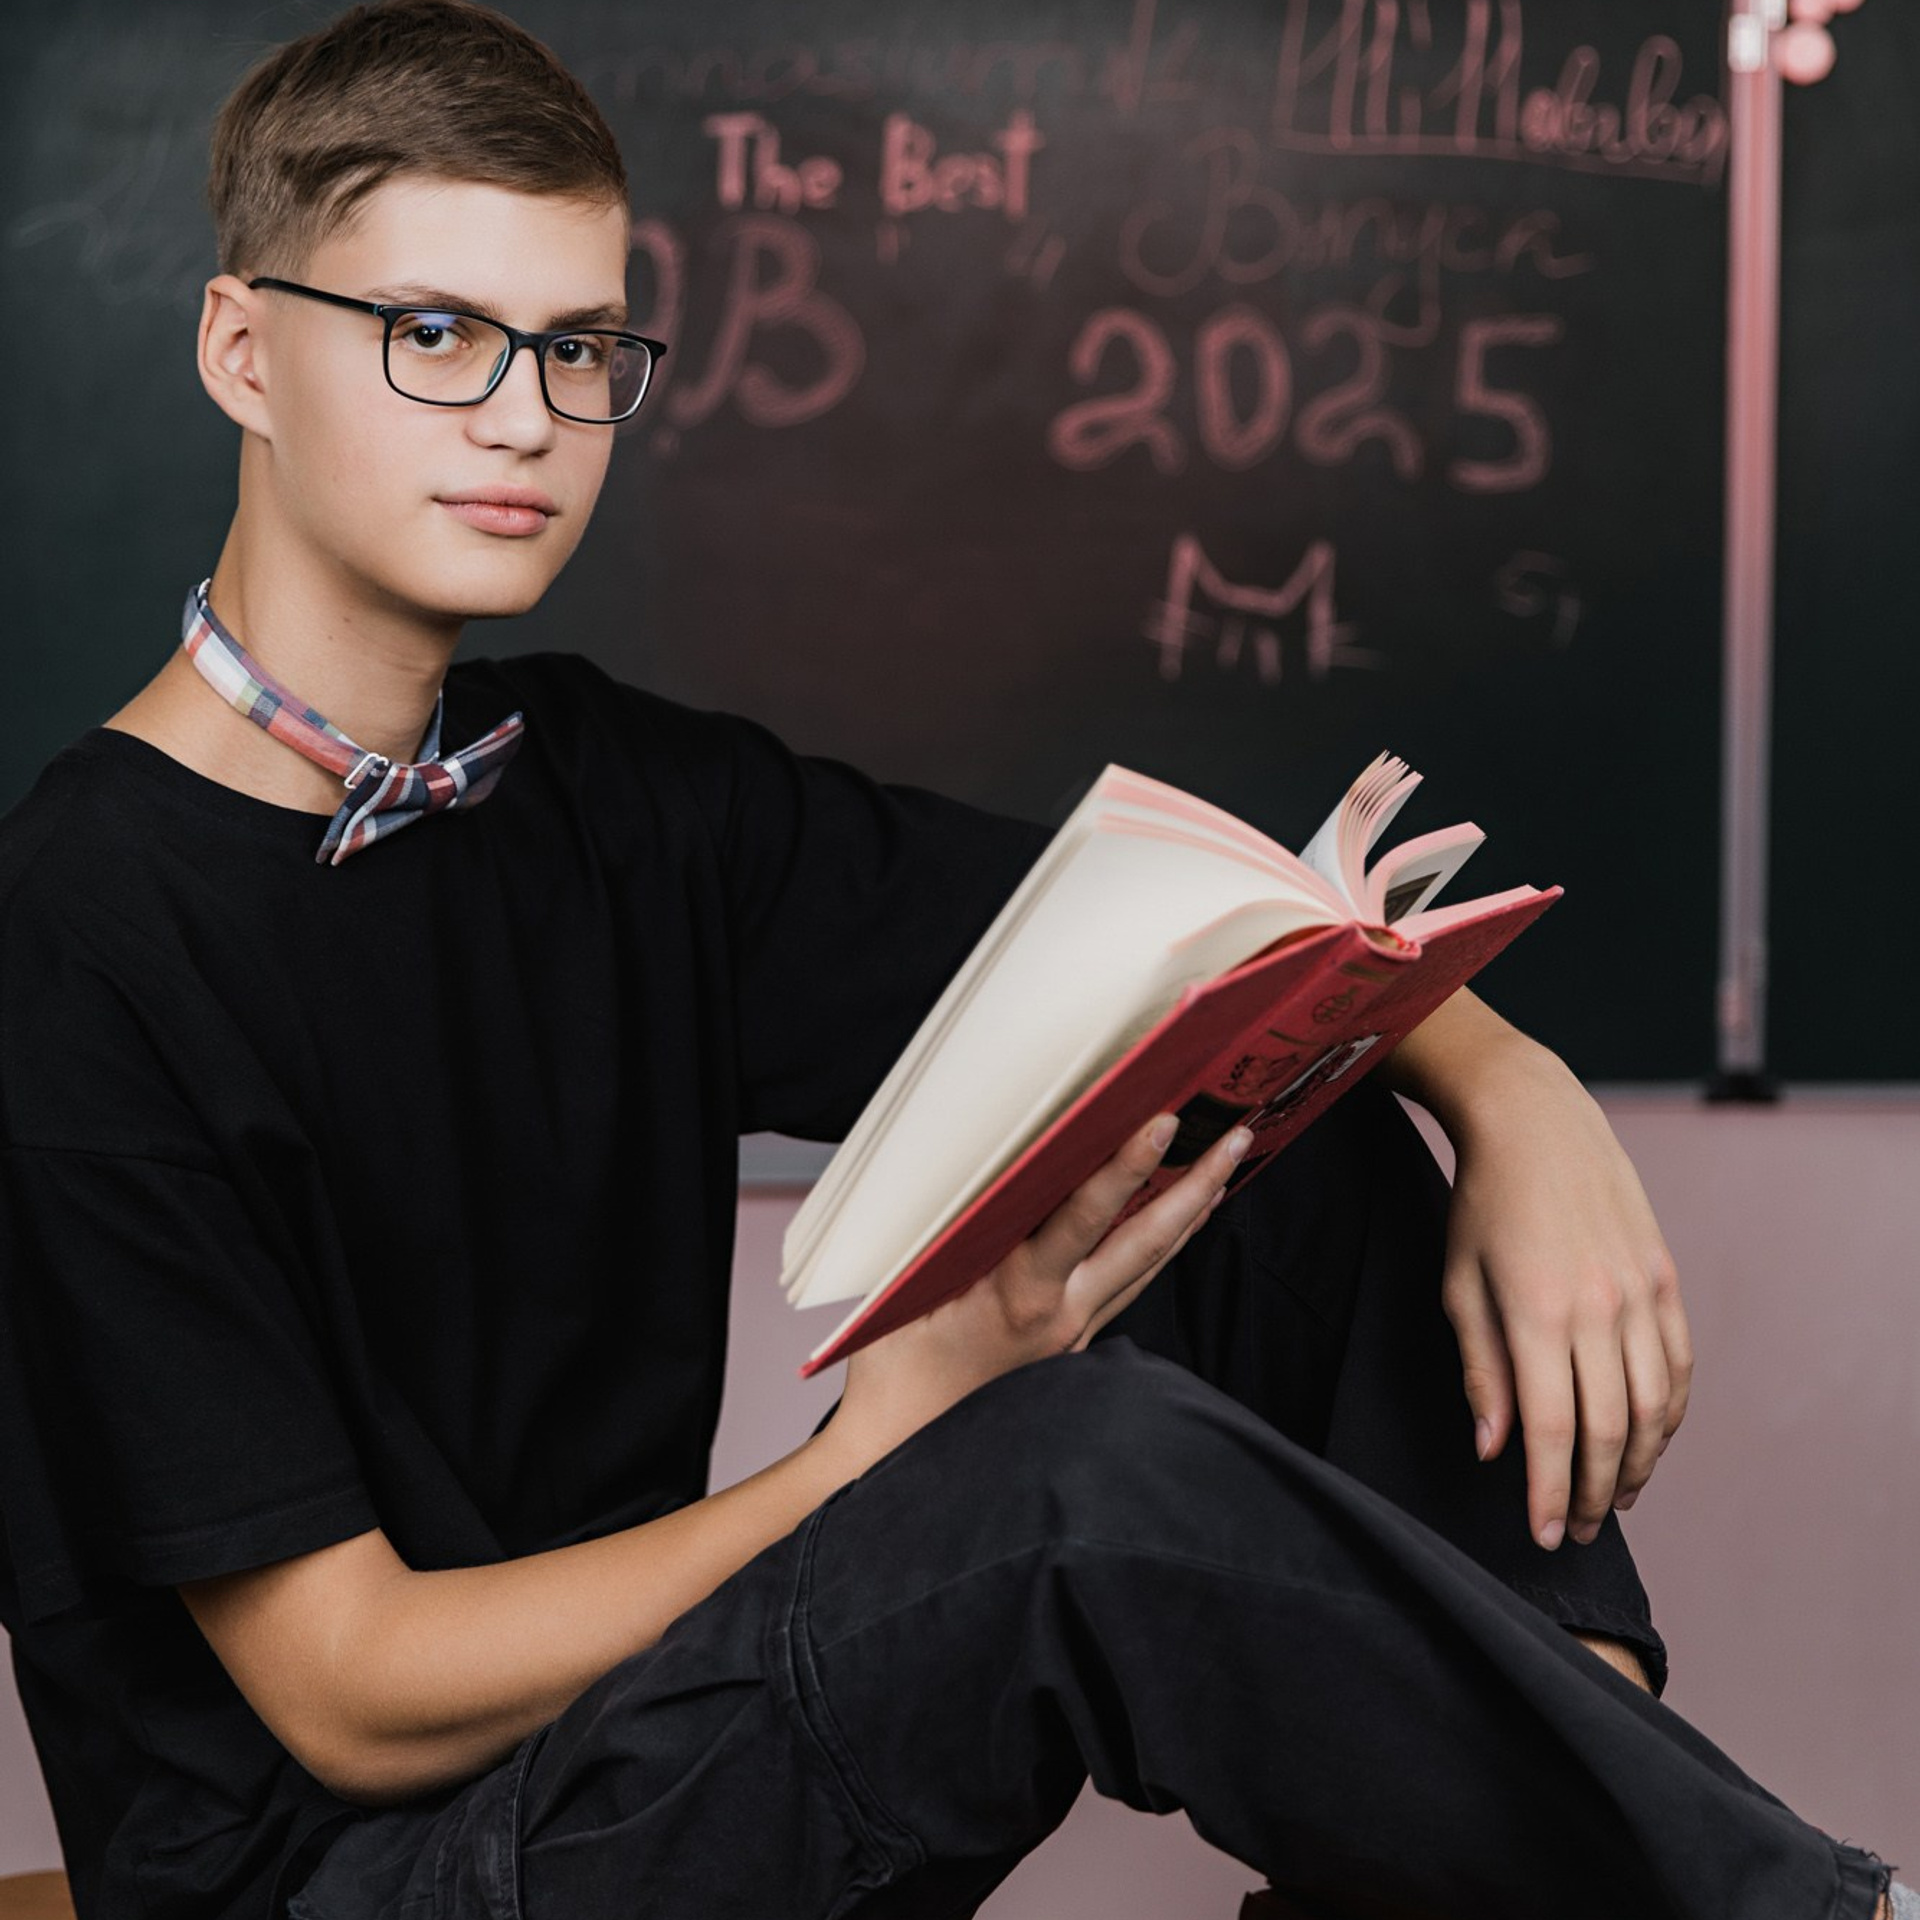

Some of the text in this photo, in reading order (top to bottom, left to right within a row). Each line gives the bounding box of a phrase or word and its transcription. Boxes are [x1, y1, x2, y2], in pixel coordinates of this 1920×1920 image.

[703, 109, 1045, 220] The Best
[1046, 303, 1564, 492] 2025
